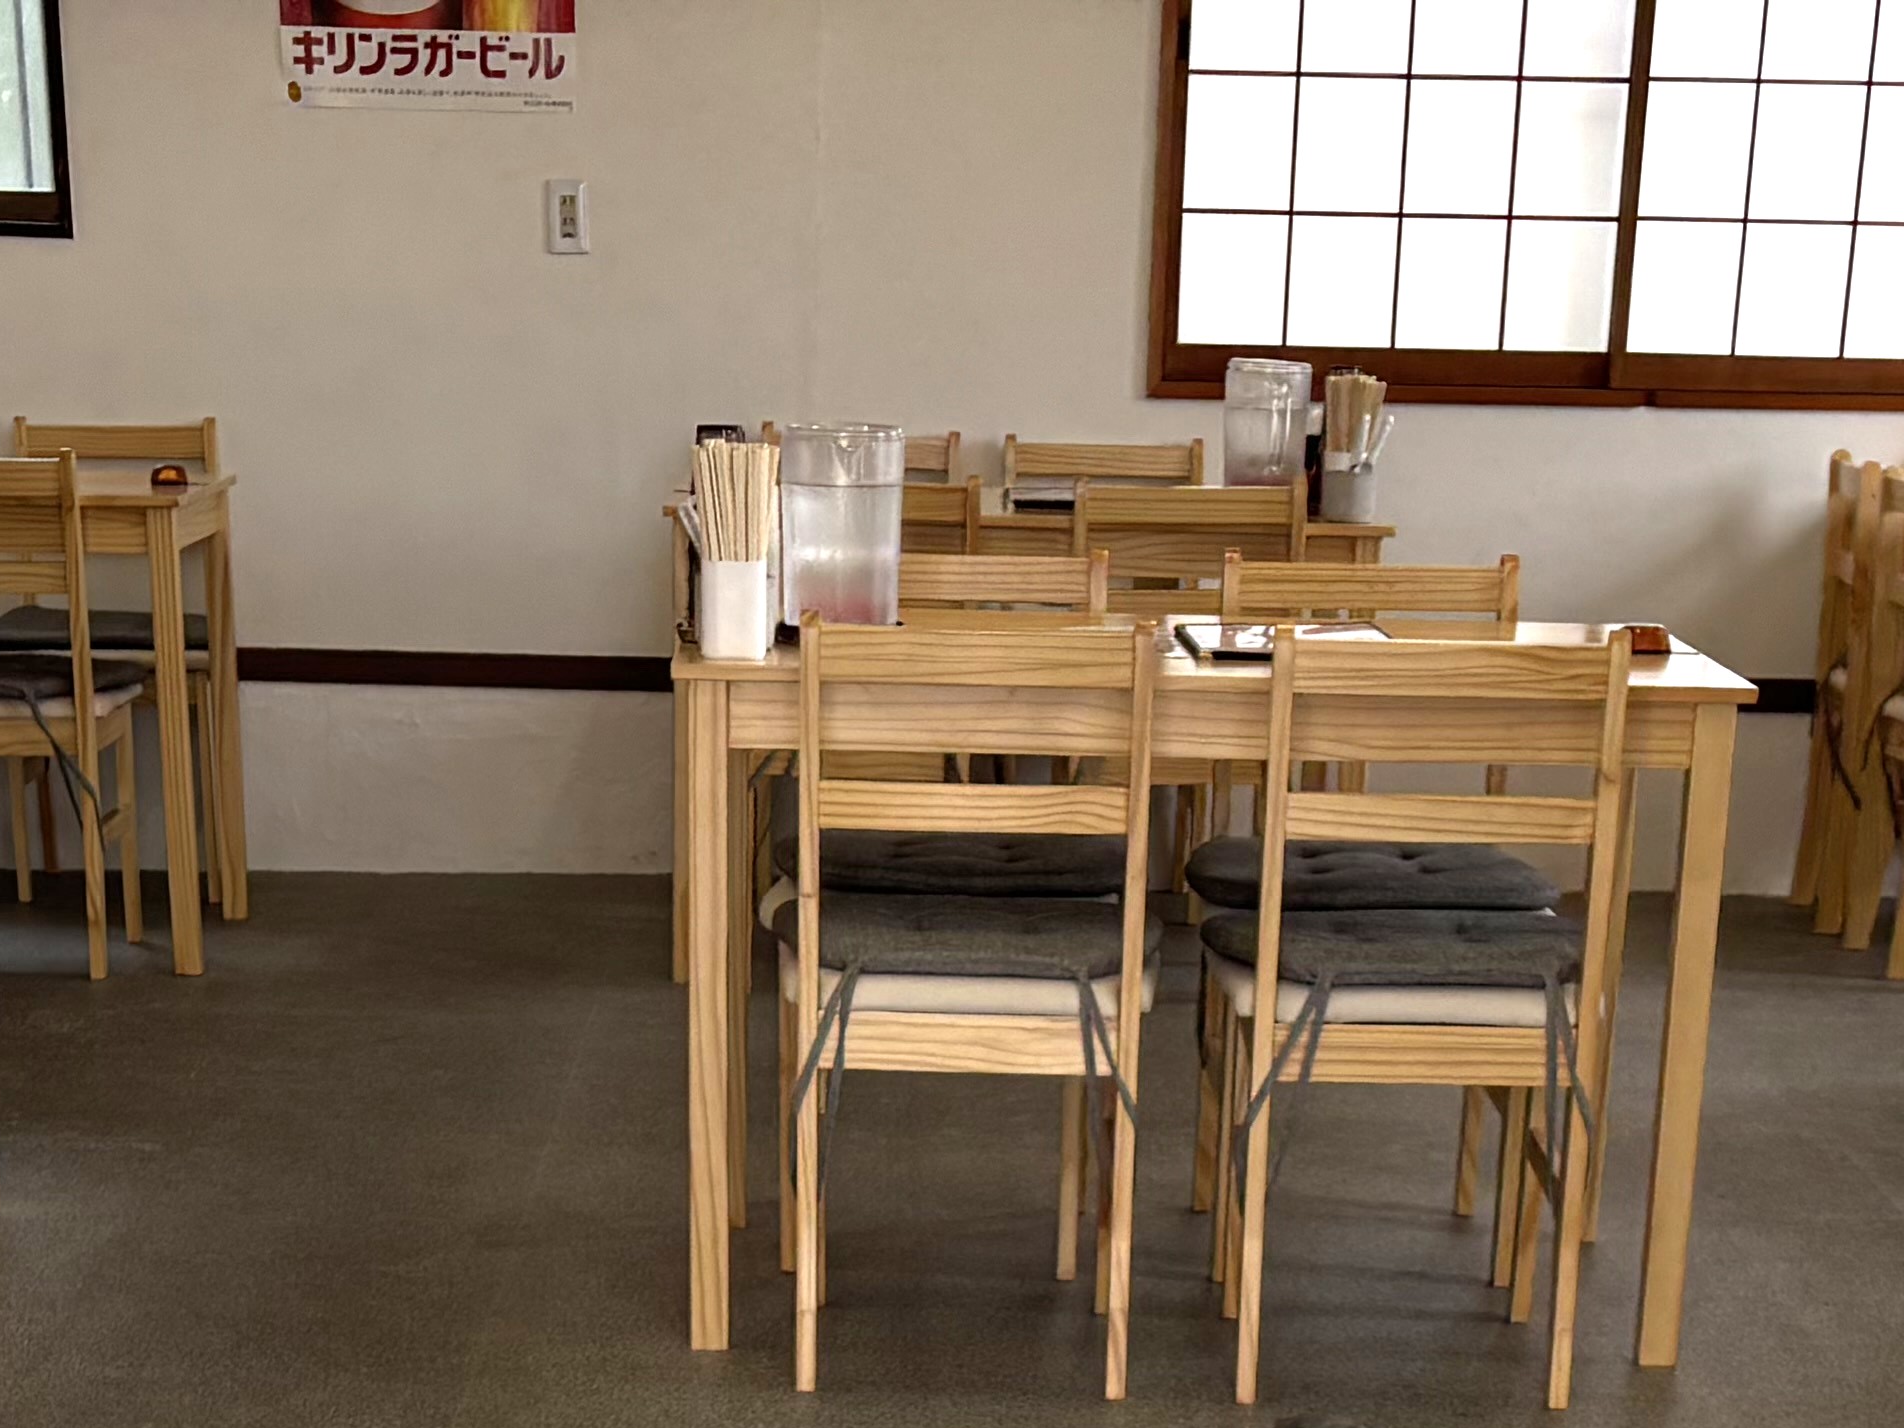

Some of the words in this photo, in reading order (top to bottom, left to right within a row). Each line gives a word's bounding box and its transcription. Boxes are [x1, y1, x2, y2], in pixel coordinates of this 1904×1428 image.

[291, 30, 566, 80] キリンラガービール
